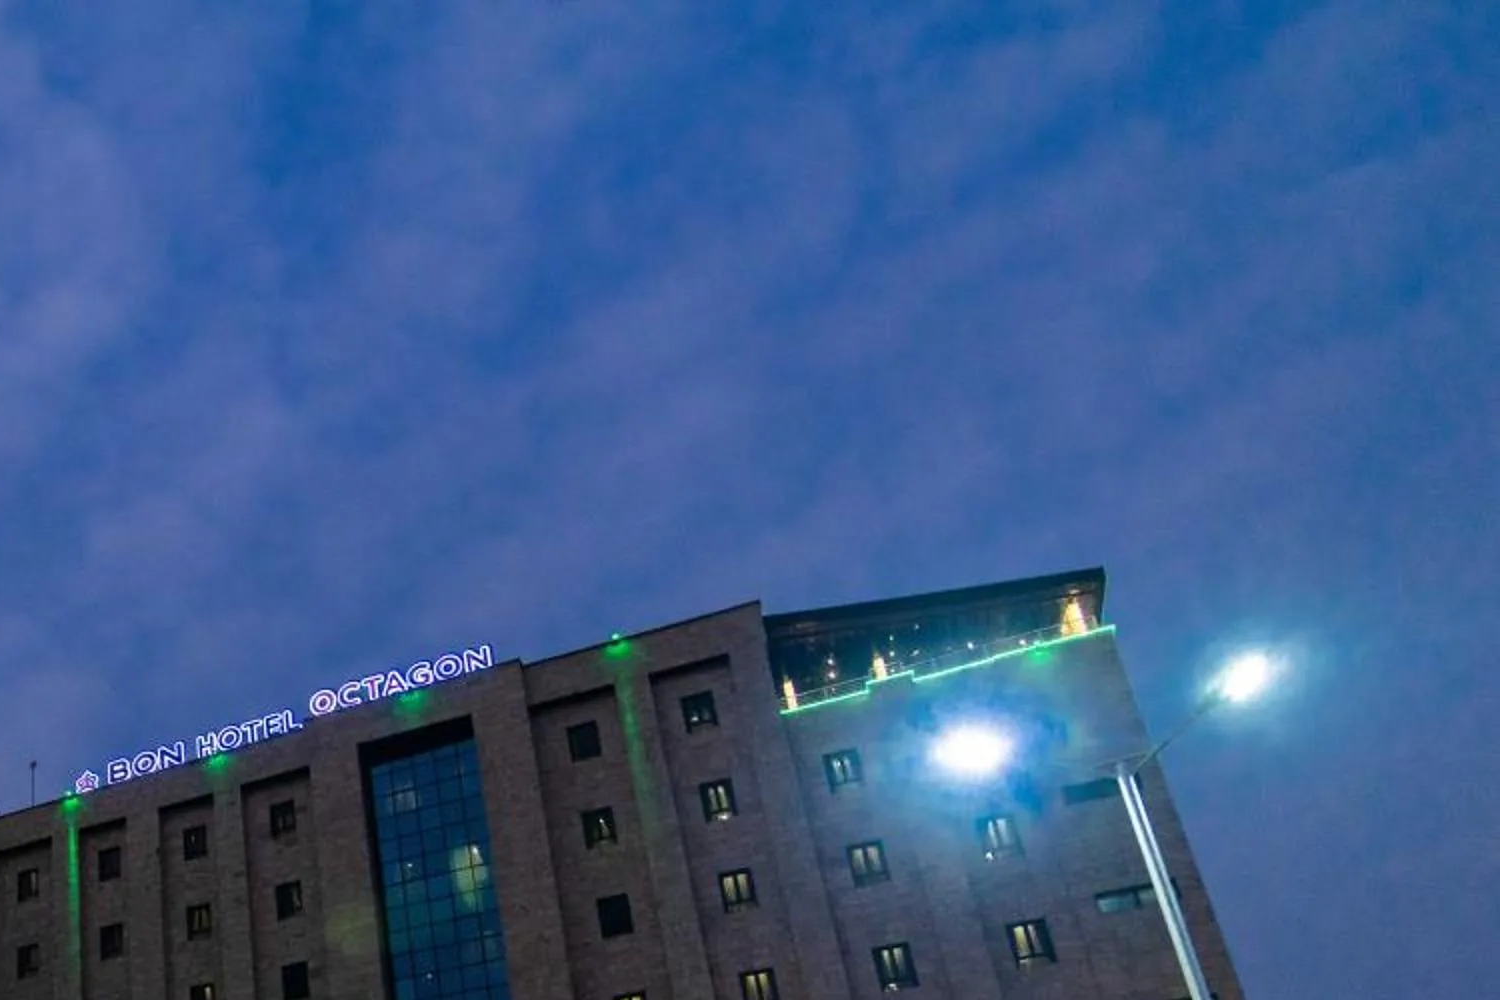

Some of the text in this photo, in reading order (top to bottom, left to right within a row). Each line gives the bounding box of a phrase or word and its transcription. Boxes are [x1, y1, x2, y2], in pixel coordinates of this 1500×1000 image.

[107, 645, 495, 784] BON HOTEL OCTAGON
